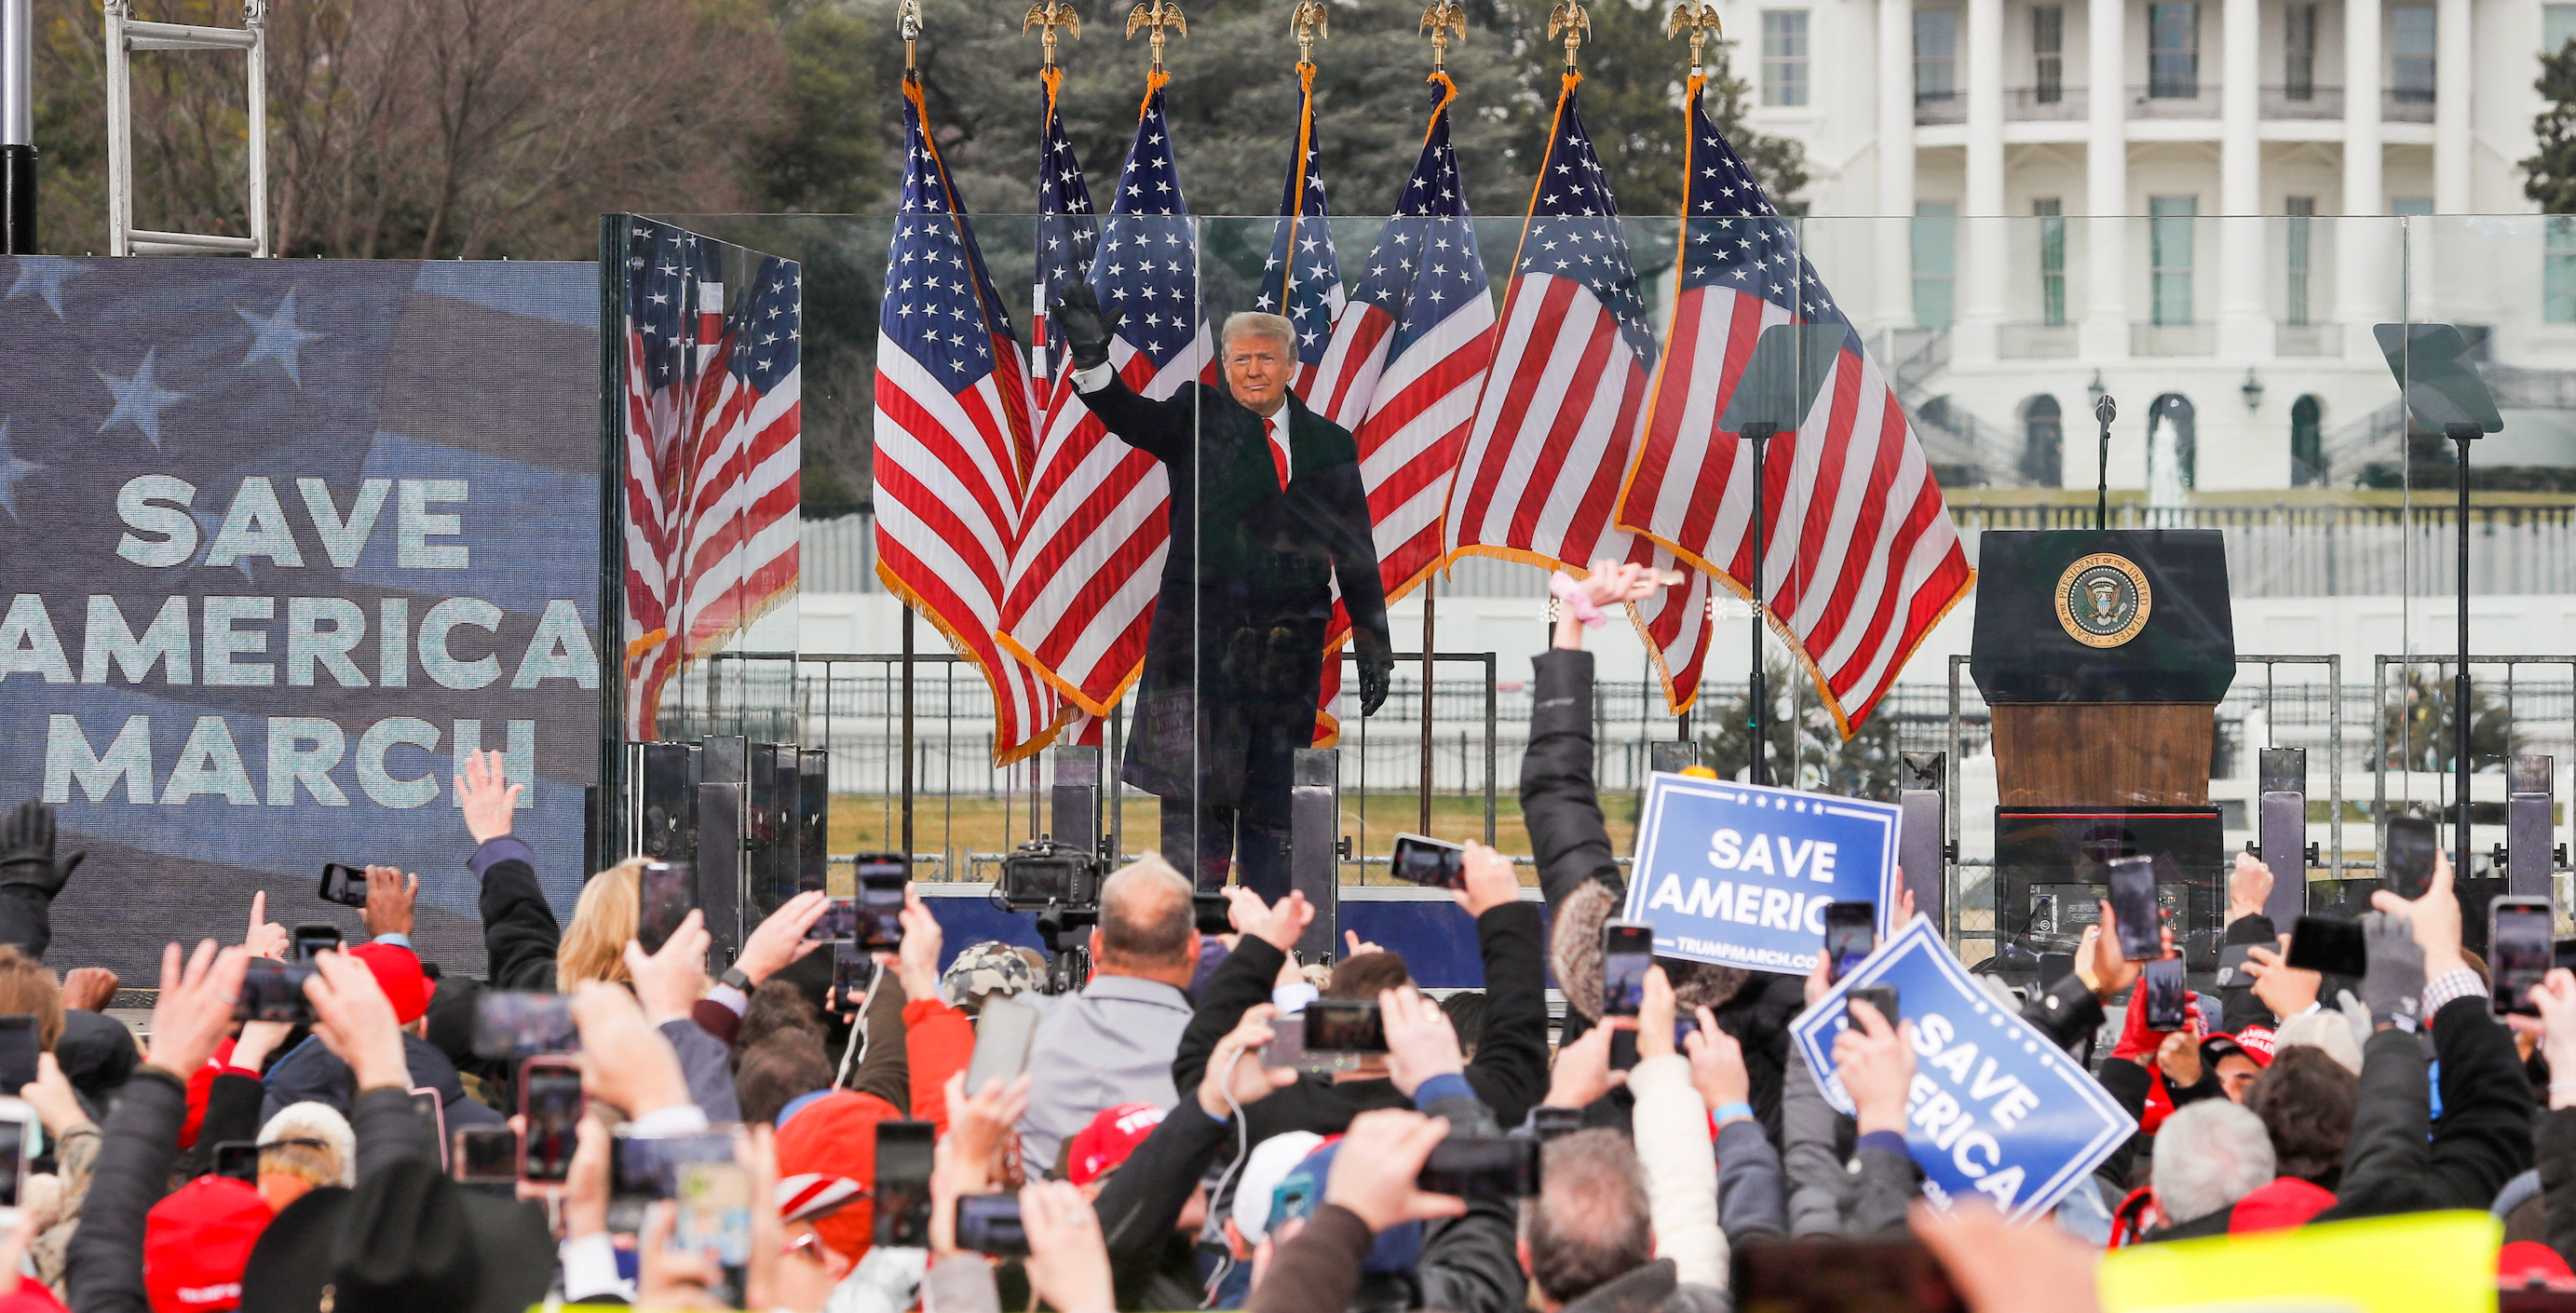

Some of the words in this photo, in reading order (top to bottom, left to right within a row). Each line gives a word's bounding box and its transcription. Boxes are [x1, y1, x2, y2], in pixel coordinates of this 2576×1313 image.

[116, 474, 469, 569] SAVE
[2058, 557, 2101, 600] PRESIDENT
[2114, 559, 2126, 569] THE
[2127, 567, 2149, 606] UNITED
[2059, 602, 2068, 616] THE
[2063, 616, 2072, 626] OF
[2112, 614, 2145, 643] STATES
[0, 593, 601, 690] AMERICA
[2072, 624, 2096, 643] SEAL
[43, 713, 536, 808] MARCH
[1708, 828, 1837, 884] SAVE
[1647, 873, 1835, 936] AMERIC
[1677, 936, 1819, 969] TRUMPMARCH.CO
[1909, 1013, 2040, 1131] SAVE
[1905, 1071, 2027, 1214] ERICA
